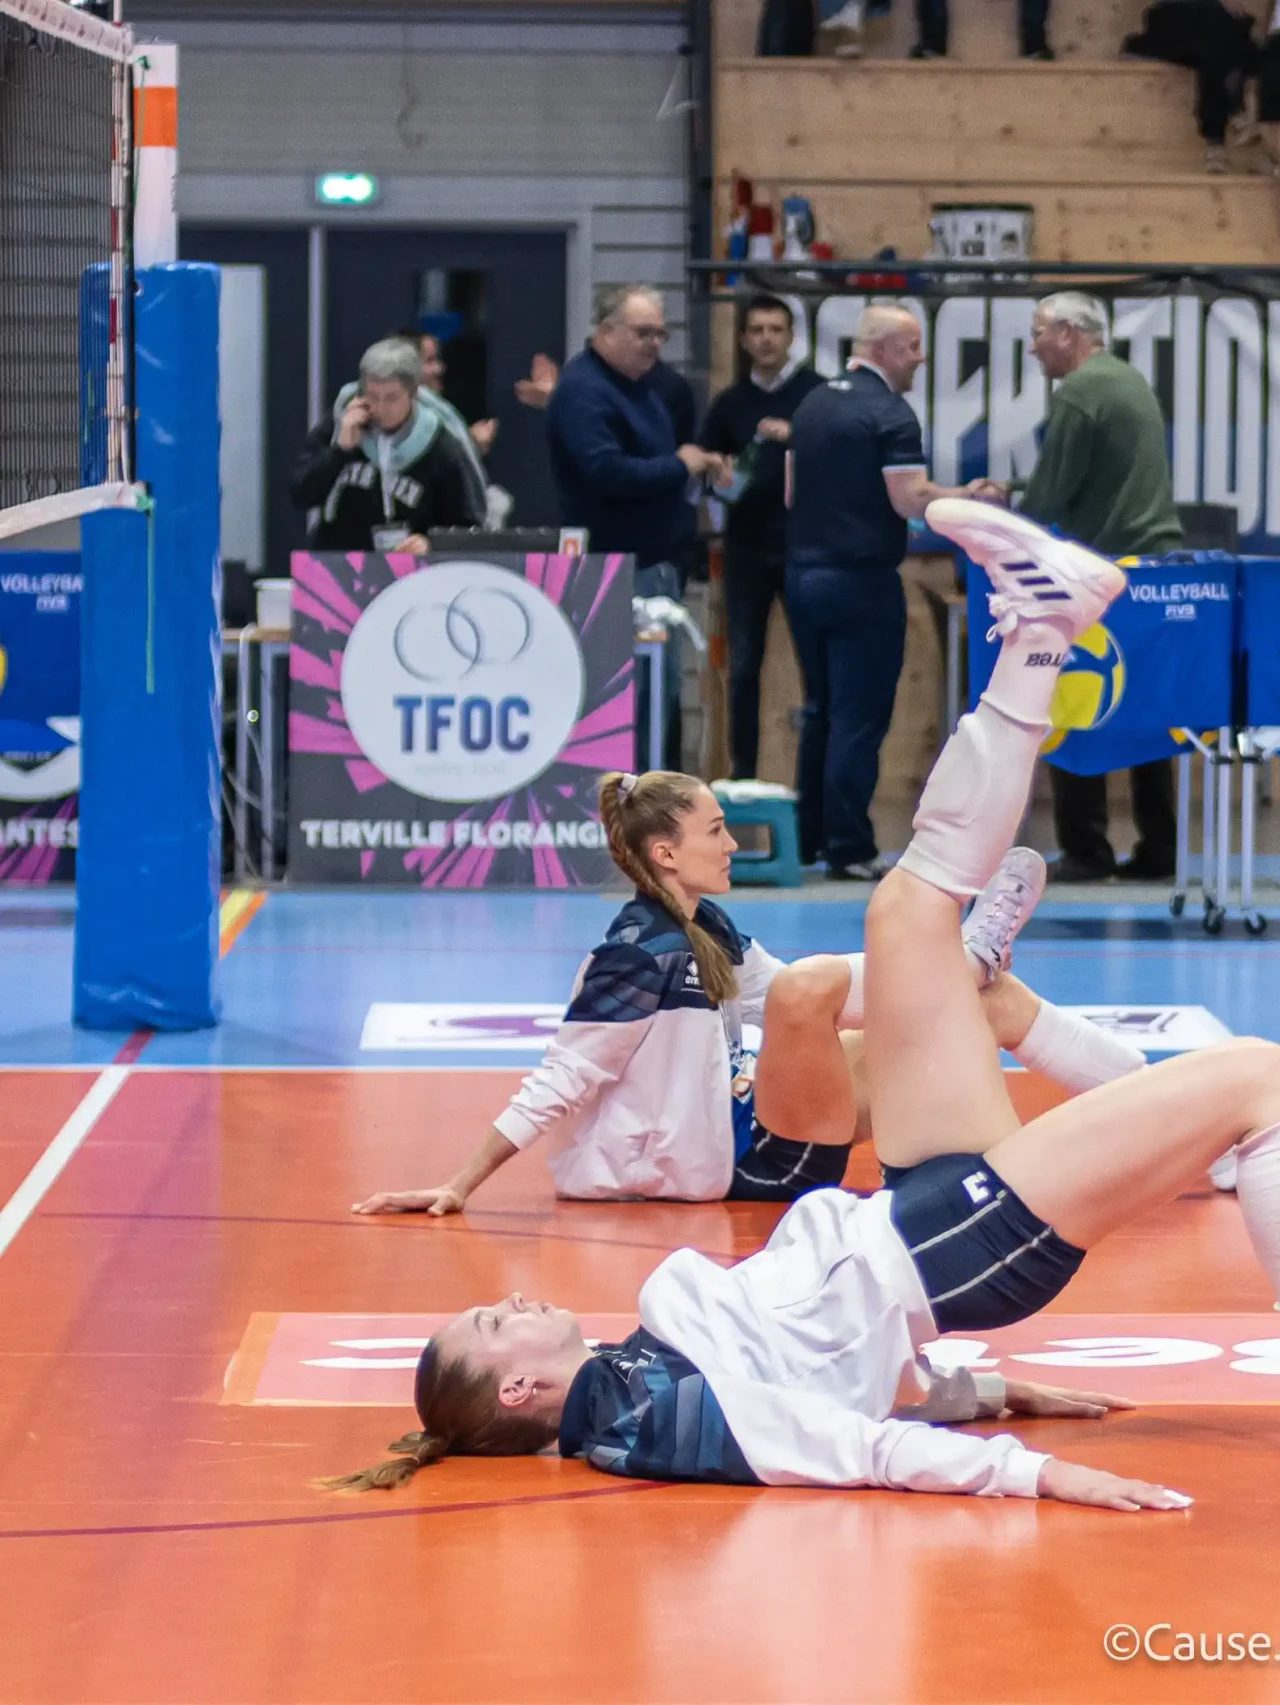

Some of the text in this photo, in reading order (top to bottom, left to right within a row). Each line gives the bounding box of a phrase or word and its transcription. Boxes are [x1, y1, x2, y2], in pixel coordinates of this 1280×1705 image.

[1129, 583, 1229, 601] VOLLEYBALL
[393, 695, 530, 753] TFOC
[301, 819, 445, 849] TERVILLE
